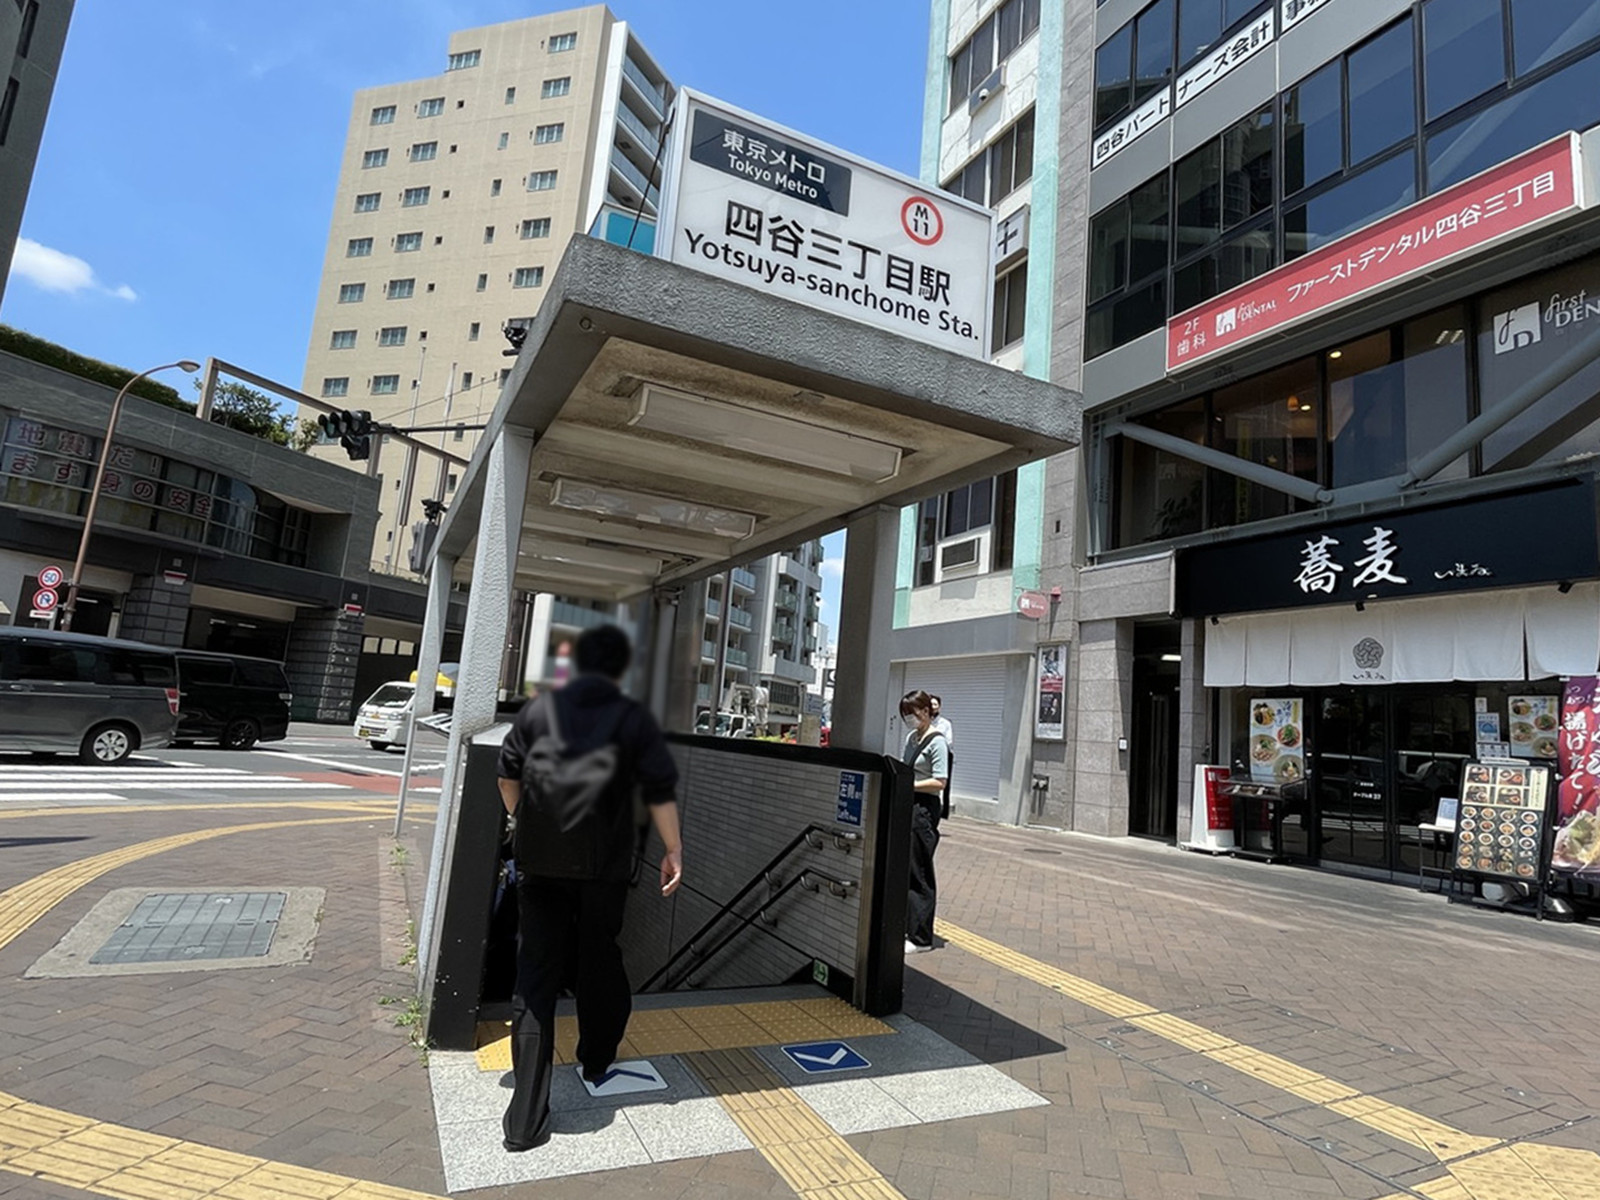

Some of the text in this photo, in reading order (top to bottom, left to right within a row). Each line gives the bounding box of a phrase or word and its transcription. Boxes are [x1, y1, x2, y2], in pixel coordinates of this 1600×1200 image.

[722, 129, 826, 184] 東京メトロ
[727, 153, 818, 199] Tokyo Metro
[725, 199, 951, 307] 四谷三丁目駅
[1287, 170, 1554, 303] ファーストデンタル四谷三丁目
[684, 228, 979, 340] Yotsuya-sanchome Sta.
[1544, 289, 1587, 323] first
[1184, 316, 1200, 336] 2F
[1241, 300, 1277, 322] DENTAL
[1177, 331, 1206, 357] 歯科
[12, 451, 213, 520] まず身の安全
[44, 571, 57, 584] 50
[1293, 526, 1407, 594] 蕎麦
